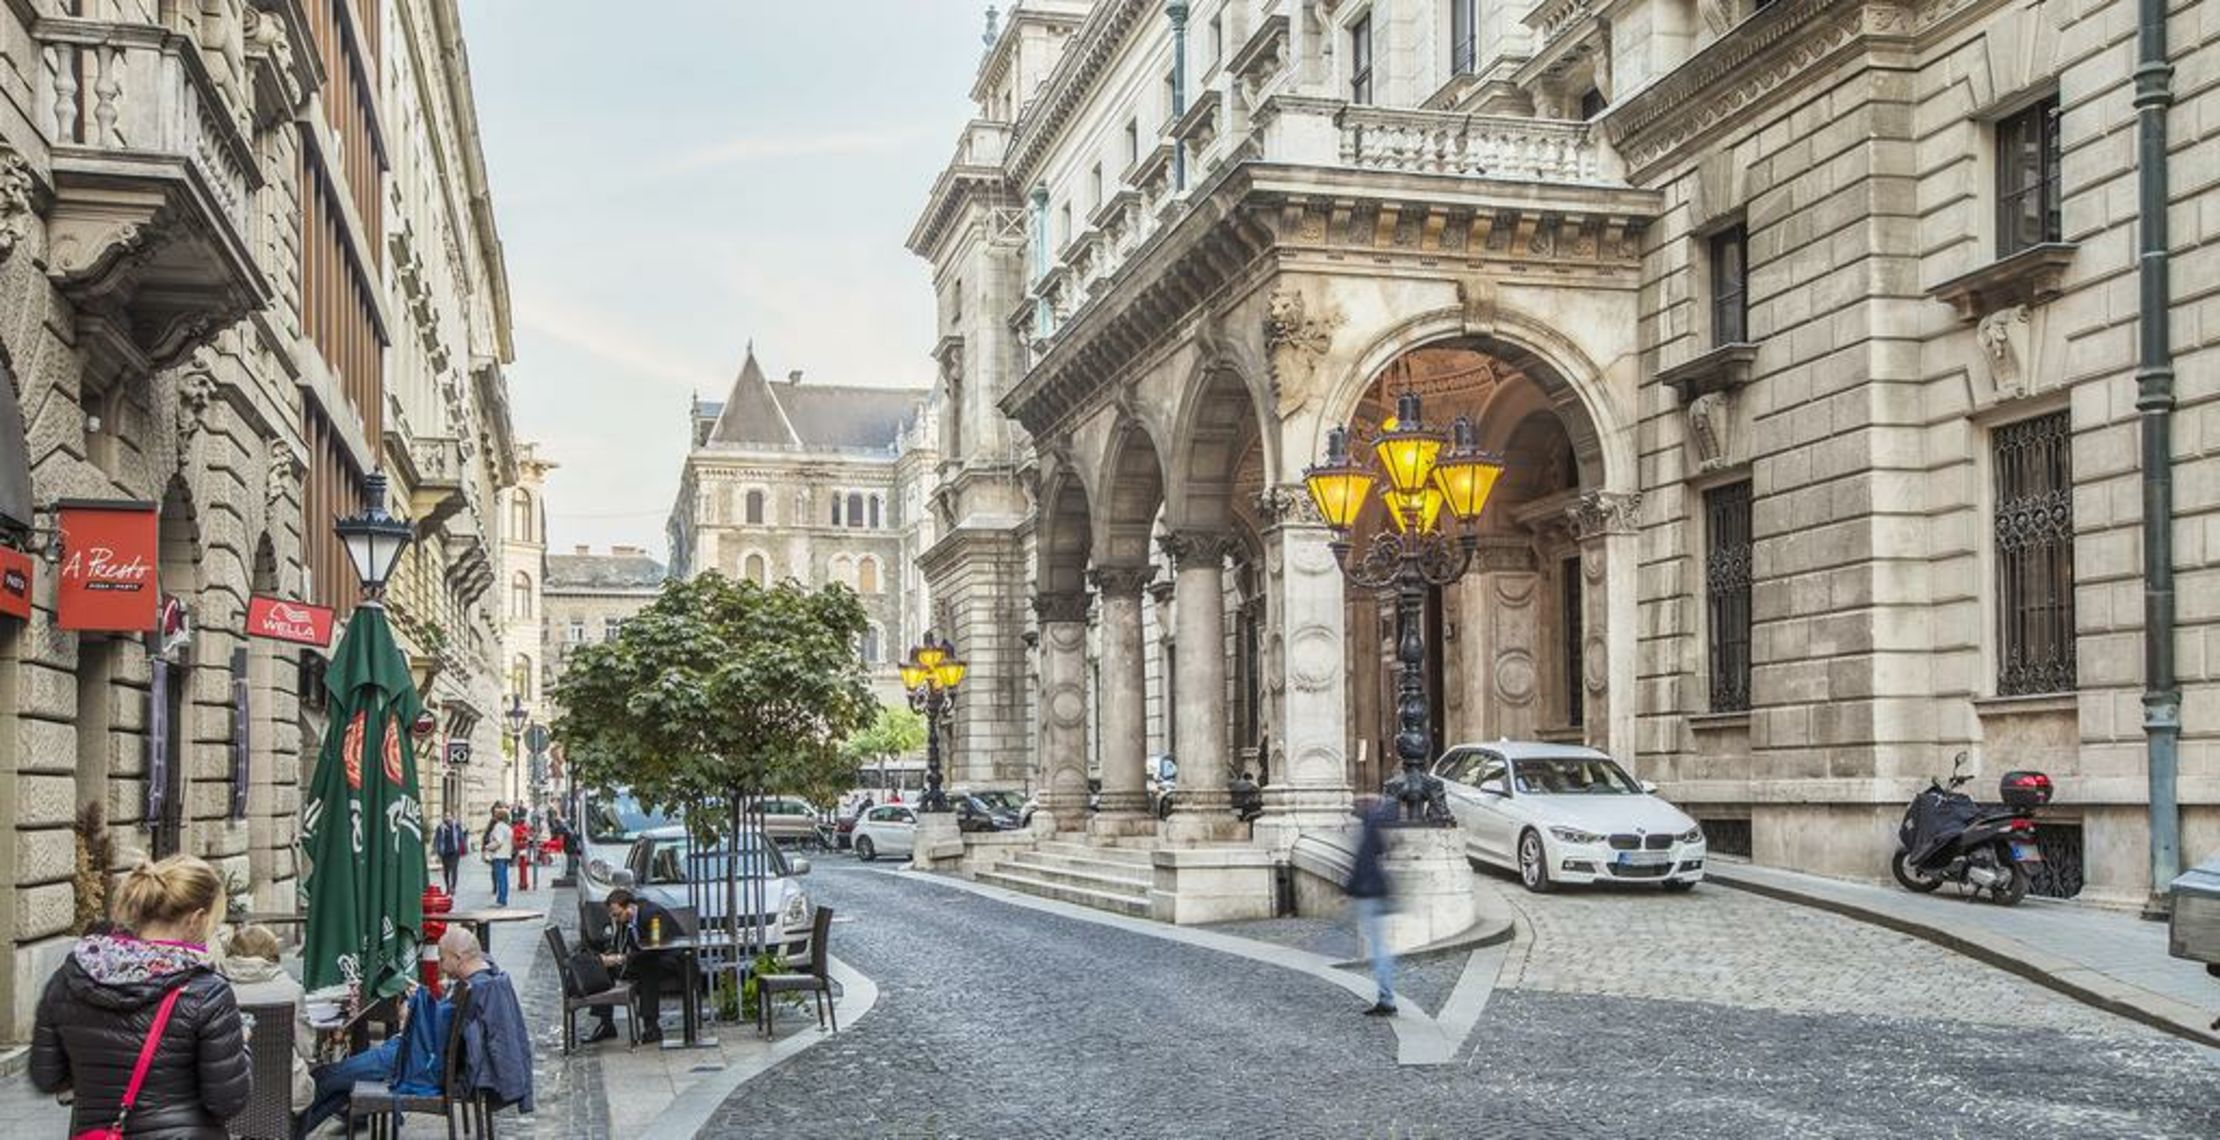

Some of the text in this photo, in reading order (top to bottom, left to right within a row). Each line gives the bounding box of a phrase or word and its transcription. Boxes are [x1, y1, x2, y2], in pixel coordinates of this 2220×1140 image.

[62, 547, 151, 579] A Presto
[262, 618, 316, 639] WELLA
